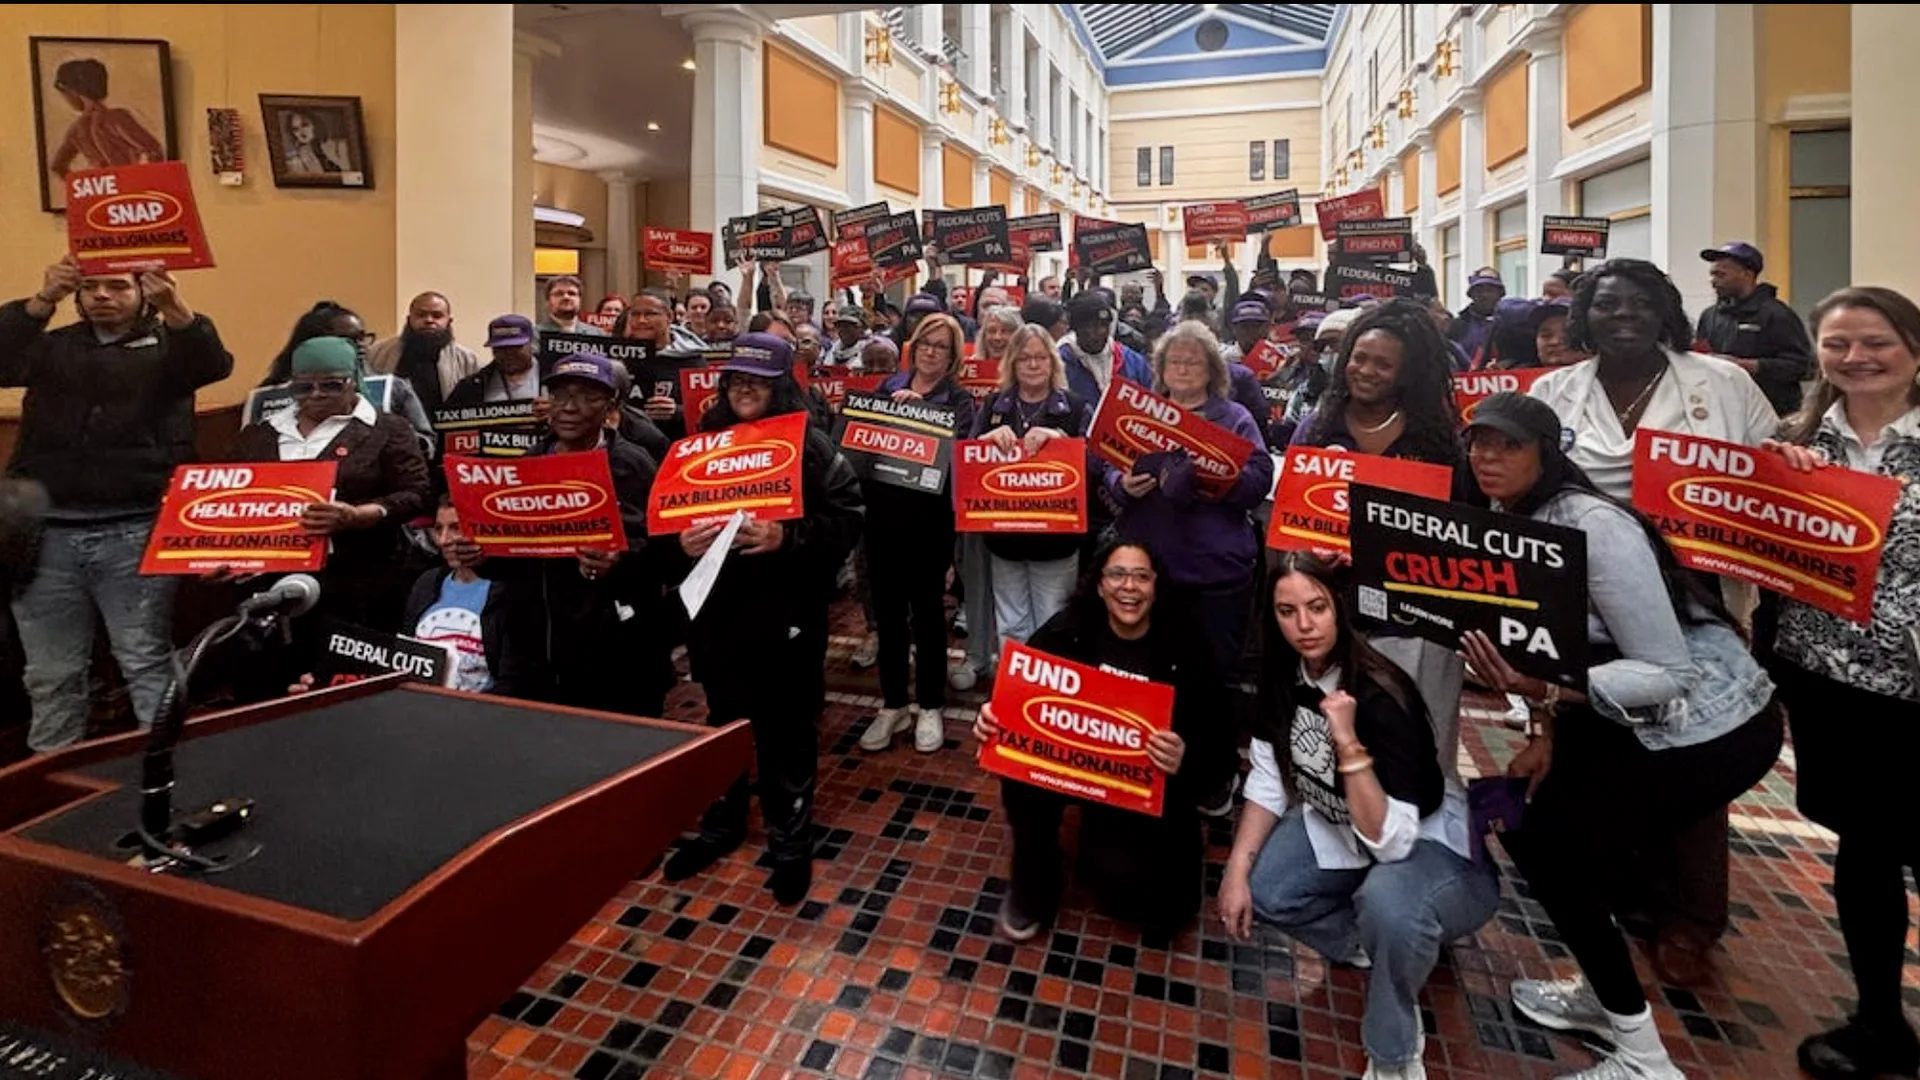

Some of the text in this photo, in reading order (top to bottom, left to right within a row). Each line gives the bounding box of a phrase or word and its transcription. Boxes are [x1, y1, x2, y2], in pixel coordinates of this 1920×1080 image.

[72, 175, 119, 198] SAVE
[107, 202, 164, 225] SNAP
[1186, 204, 1216, 216] FUND
[984, 243, 1004, 256] PA
[1337, 266, 1412, 288] FEDERAL CUTS
[548, 338, 647, 359] FEDERAL CUTS
[434, 403, 533, 421] TAX BILLIONAIRE
[847, 395, 872, 410] TAX
[1118, 384, 1182, 426] FUND
[483, 432, 511, 447] TAX
[675, 430, 734, 458] SAVE
[853, 428, 925, 458] FUND PA
[705, 451, 773, 477] PENNIE
[964, 445, 1022, 463] FUND
[1650, 436, 1755, 477] FUND
[456, 463, 522, 485] SAVE
[1293, 453, 1356, 481] SAVE
[181, 468, 253, 490] FUND
[997, 472, 1065, 487] TRANSIT
[494, 491, 590, 512] MEDICAID
[659, 493, 689, 508] TAX
[1282, 511, 1312, 529] TAX
[1648, 514, 1688, 537] TAX
[1683, 483, 1858, 547] EDUCATION
[1366, 502, 1565, 568] FEDERAL CUTS
[1385, 551, 1519, 595] CRUSH
[1500, 616, 1561, 660] PA
[329, 634, 389, 668] FEDERAL
[392, 651, 434, 677] CUTS
[1009, 651, 1081, 695] FUND
[1040, 702, 1142, 748] HOUSING
[998, 727, 1031, 750] TAX
